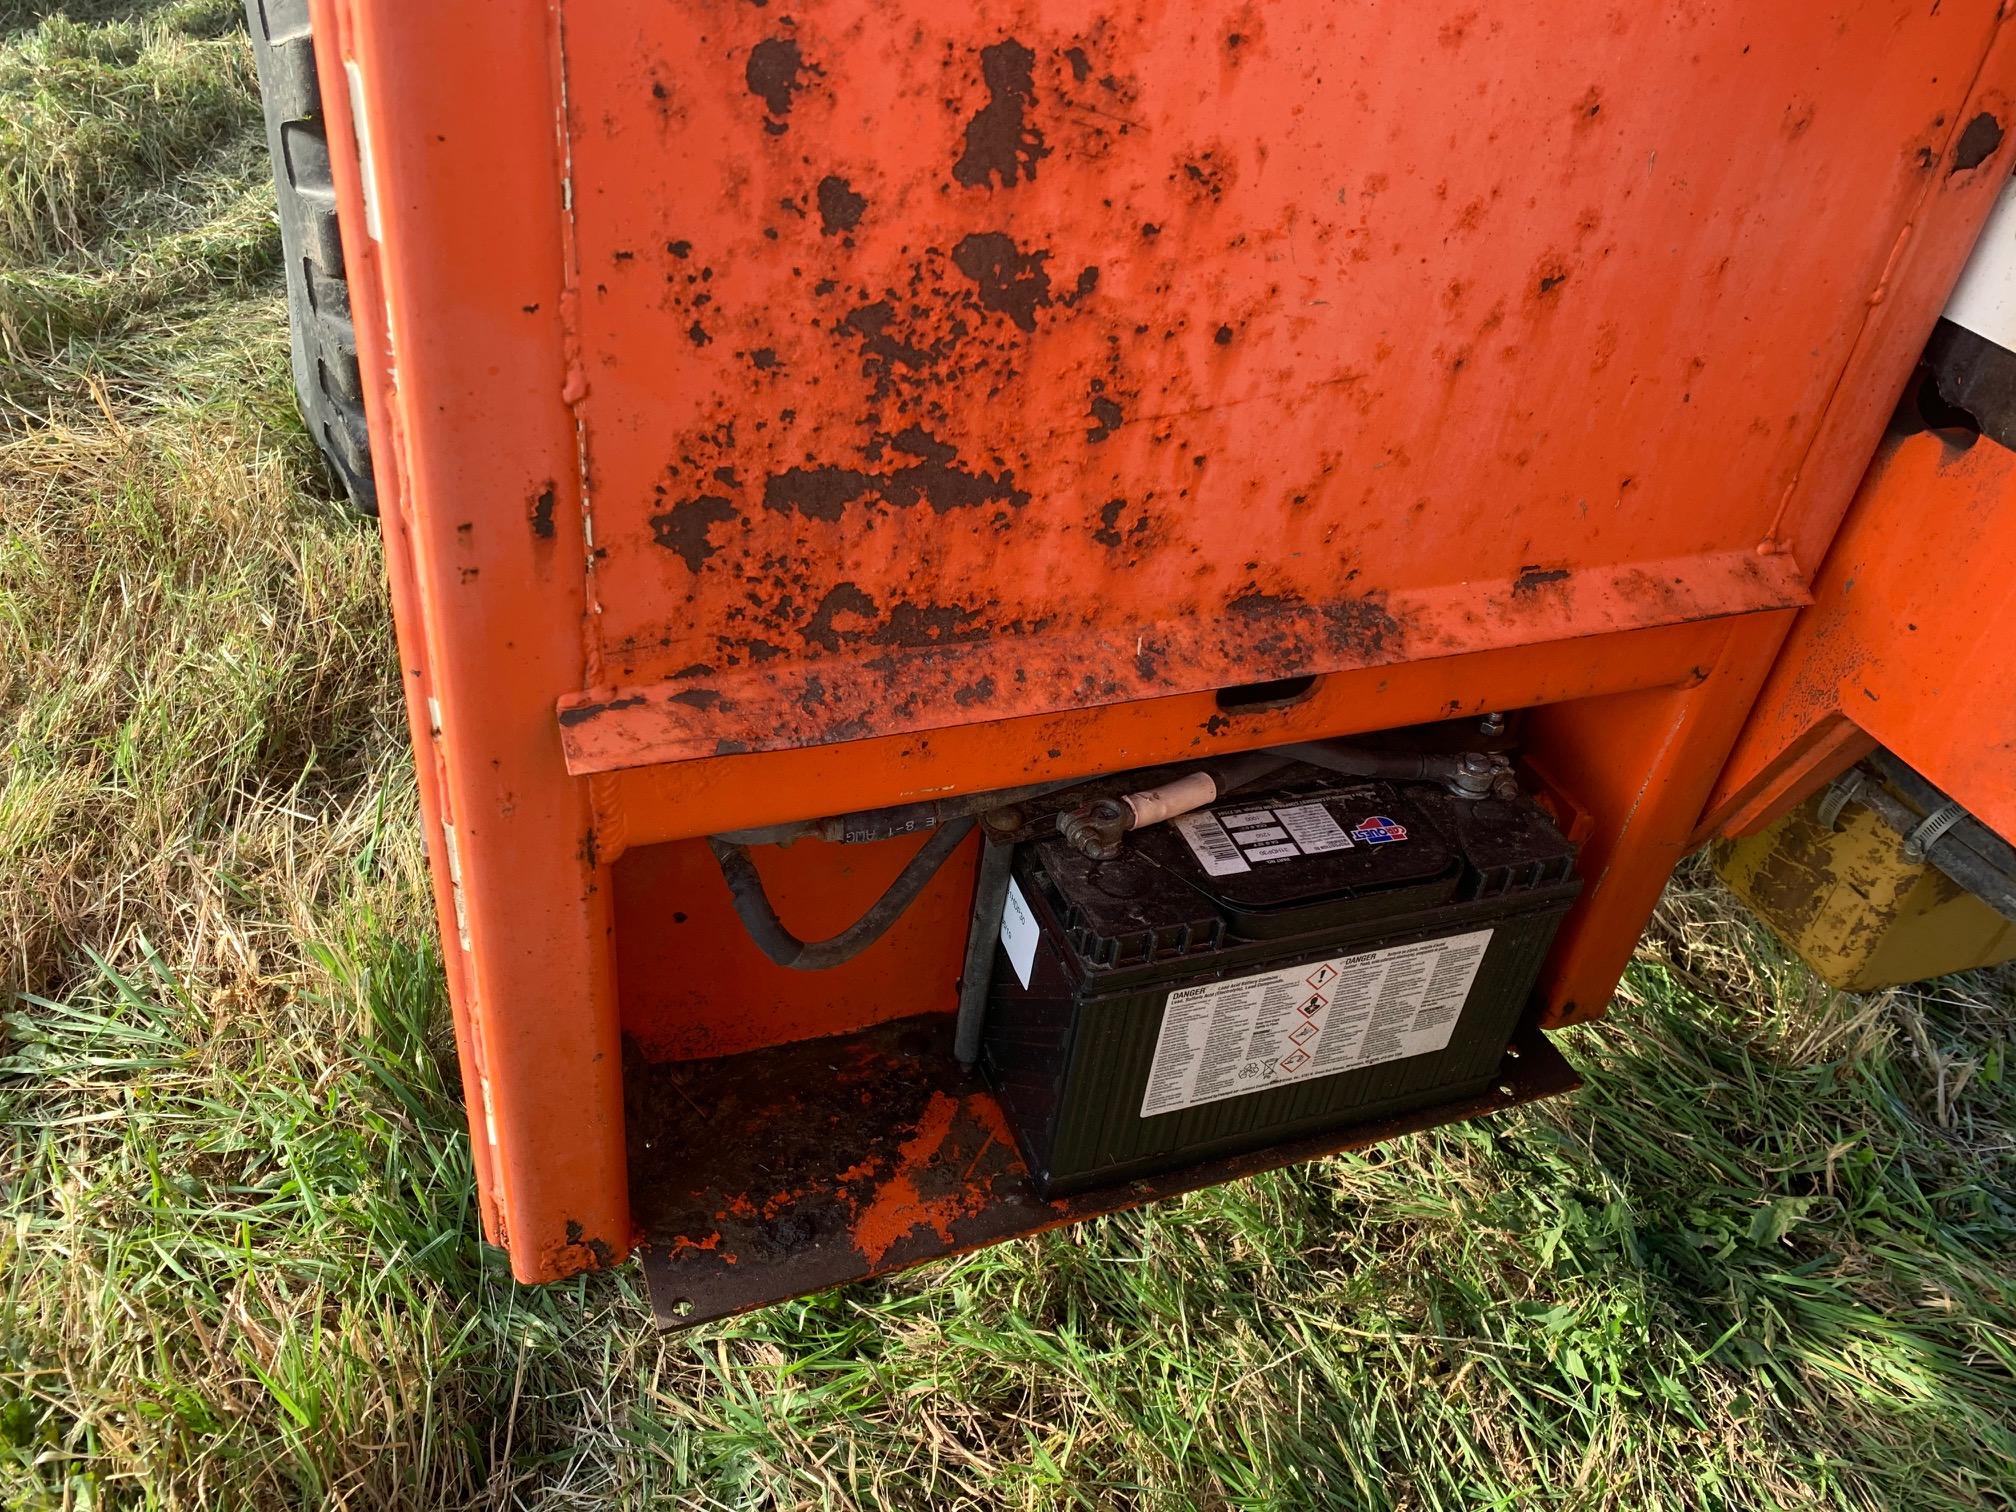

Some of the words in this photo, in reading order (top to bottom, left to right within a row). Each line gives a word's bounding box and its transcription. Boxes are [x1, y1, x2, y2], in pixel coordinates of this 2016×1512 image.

[1353, 826, 1406, 839] CARQUEST
[1345, 953, 1377, 965] DANGER
[1172, 987, 1206, 1000] DANGER
